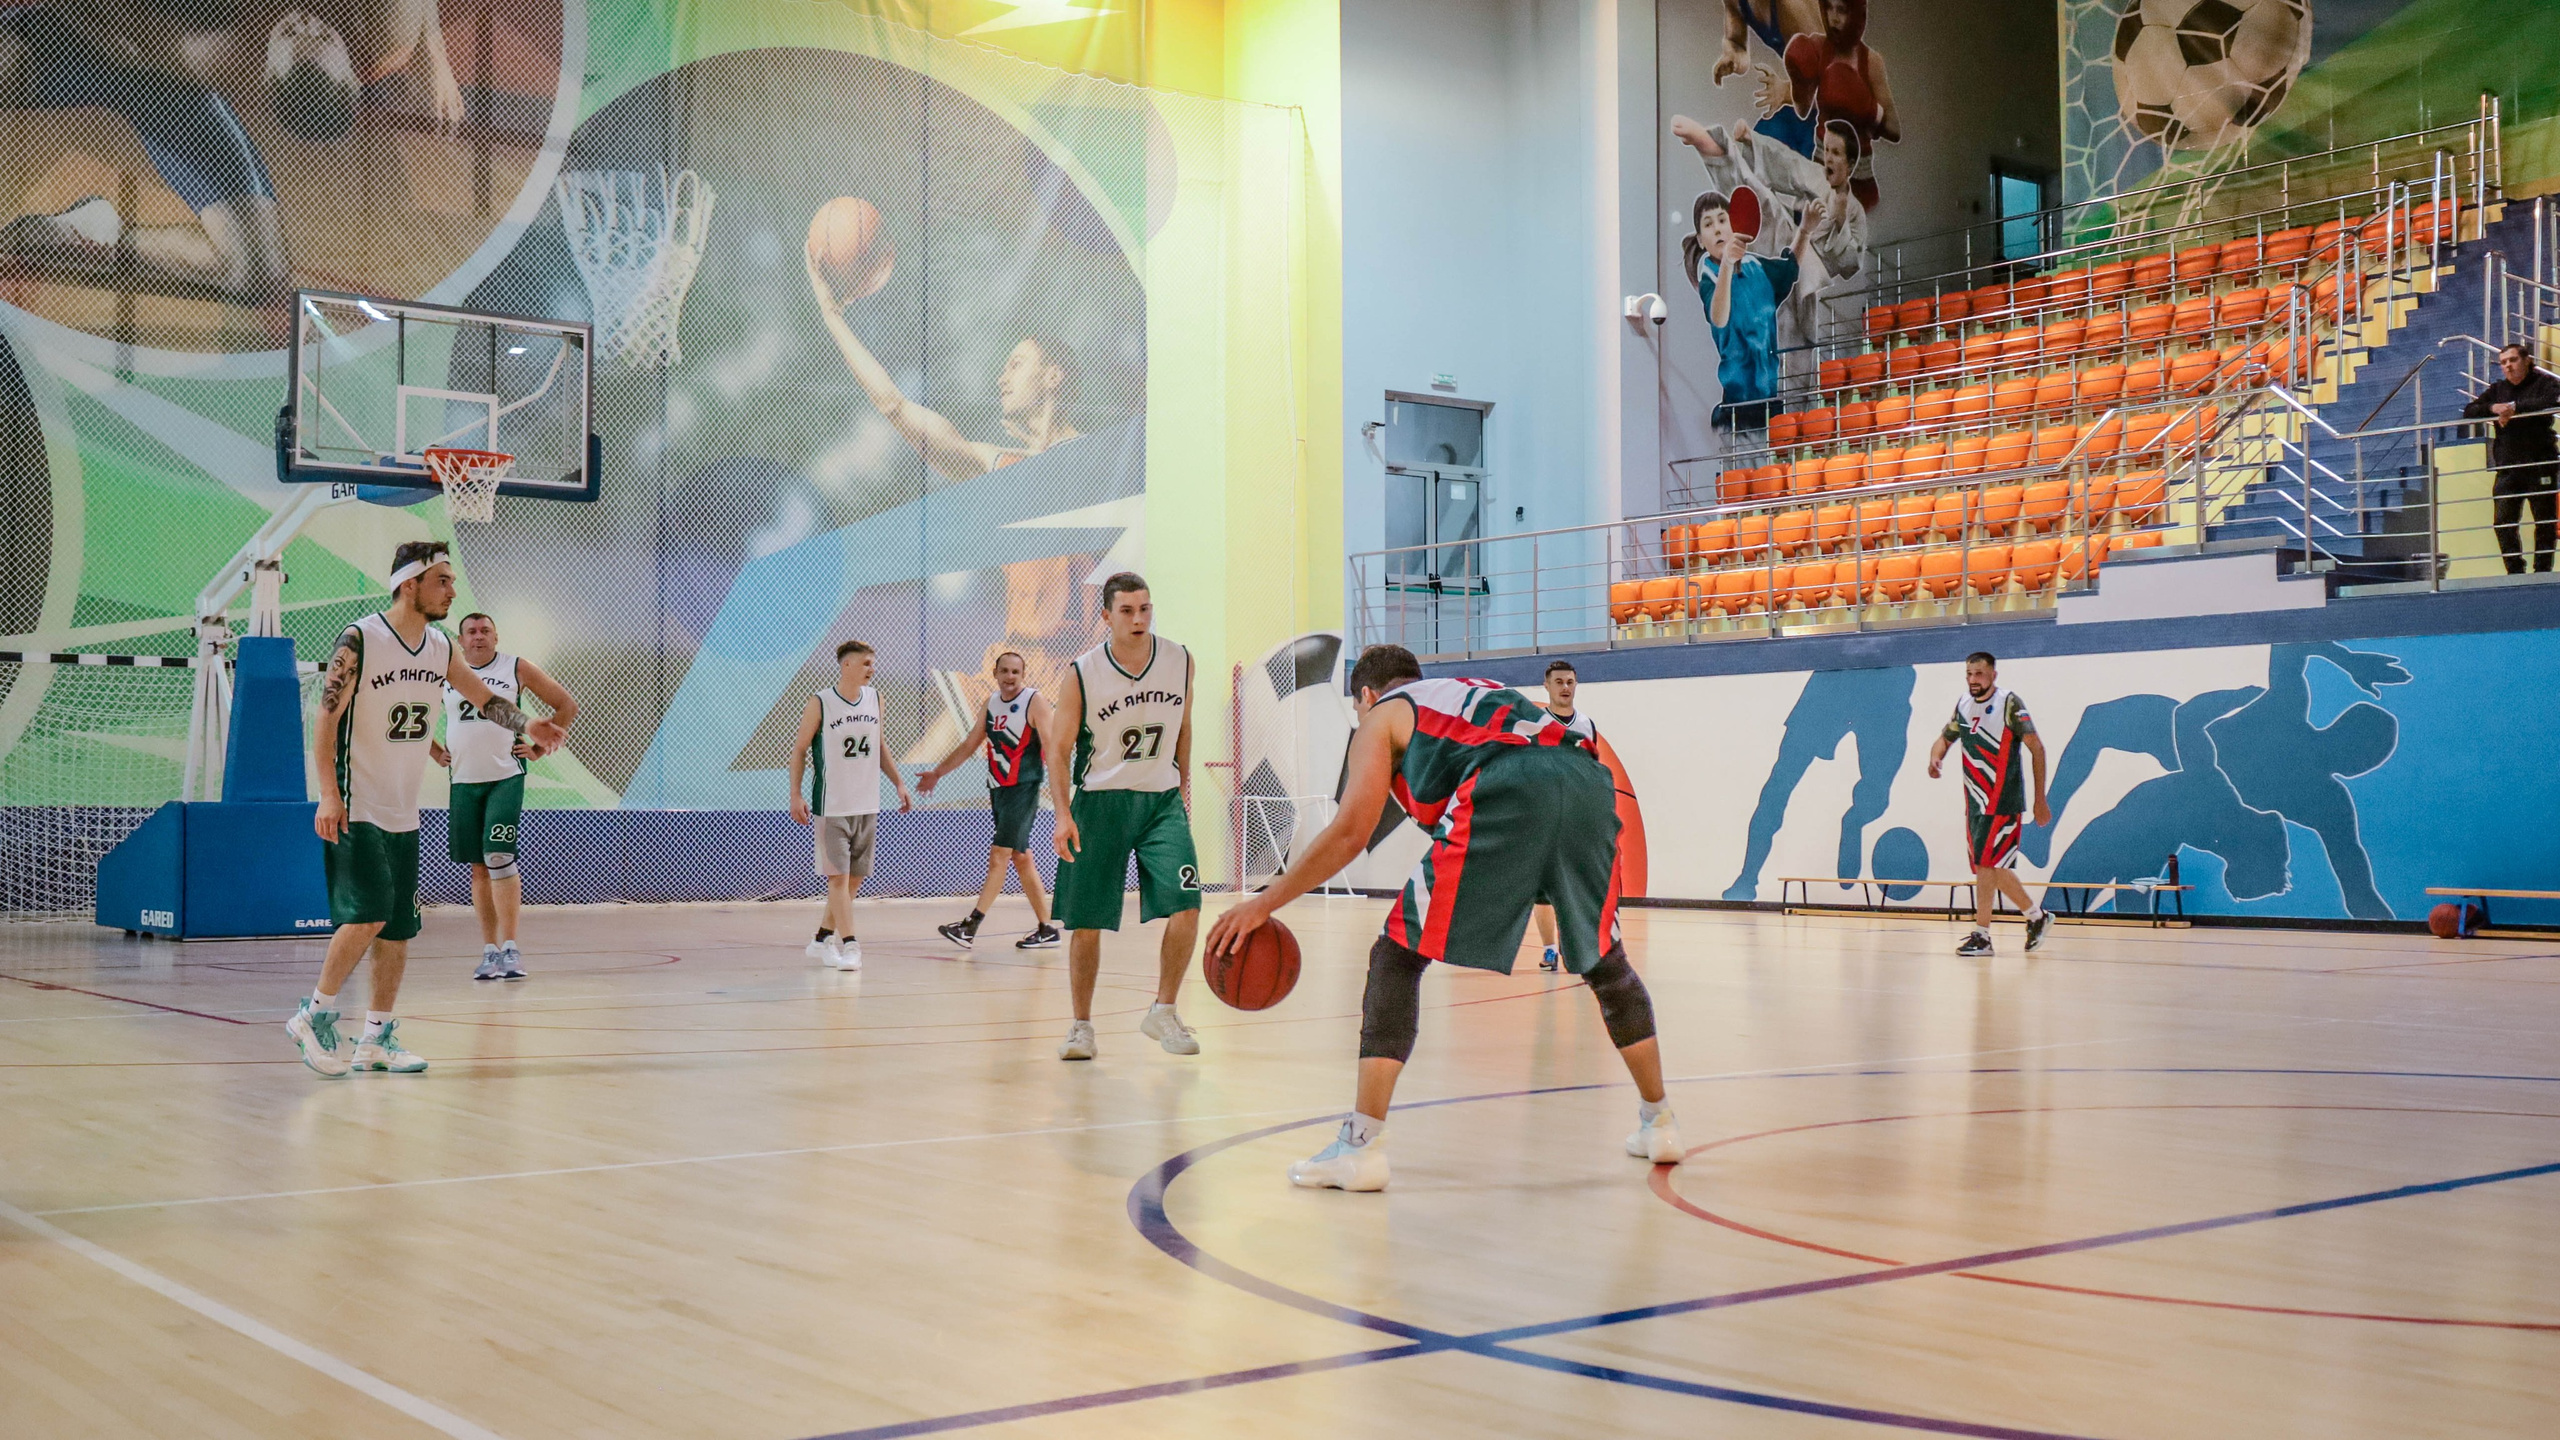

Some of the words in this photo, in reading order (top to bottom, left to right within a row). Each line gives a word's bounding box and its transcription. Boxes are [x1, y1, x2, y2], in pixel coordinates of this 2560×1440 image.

[332, 482, 356, 499] GAR
[371, 670, 395, 690] НК
[1098, 700, 1121, 721] НК
[1124, 690, 1183, 706] ЯНГПУР
[387, 702, 430, 742] 23
[830, 717, 844, 730] НК
[993, 714, 1008, 731] 12
[1970, 716, 1981, 734] 7
[842, 735, 872, 759] 24
[1120, 723, 1165, 762] 27
[490, 824, 516, 843] 28
[1179, 864, 1200, 891] 2
[141, 909, 174, 929] GARED
[295, 919, 333, 928] GARE
